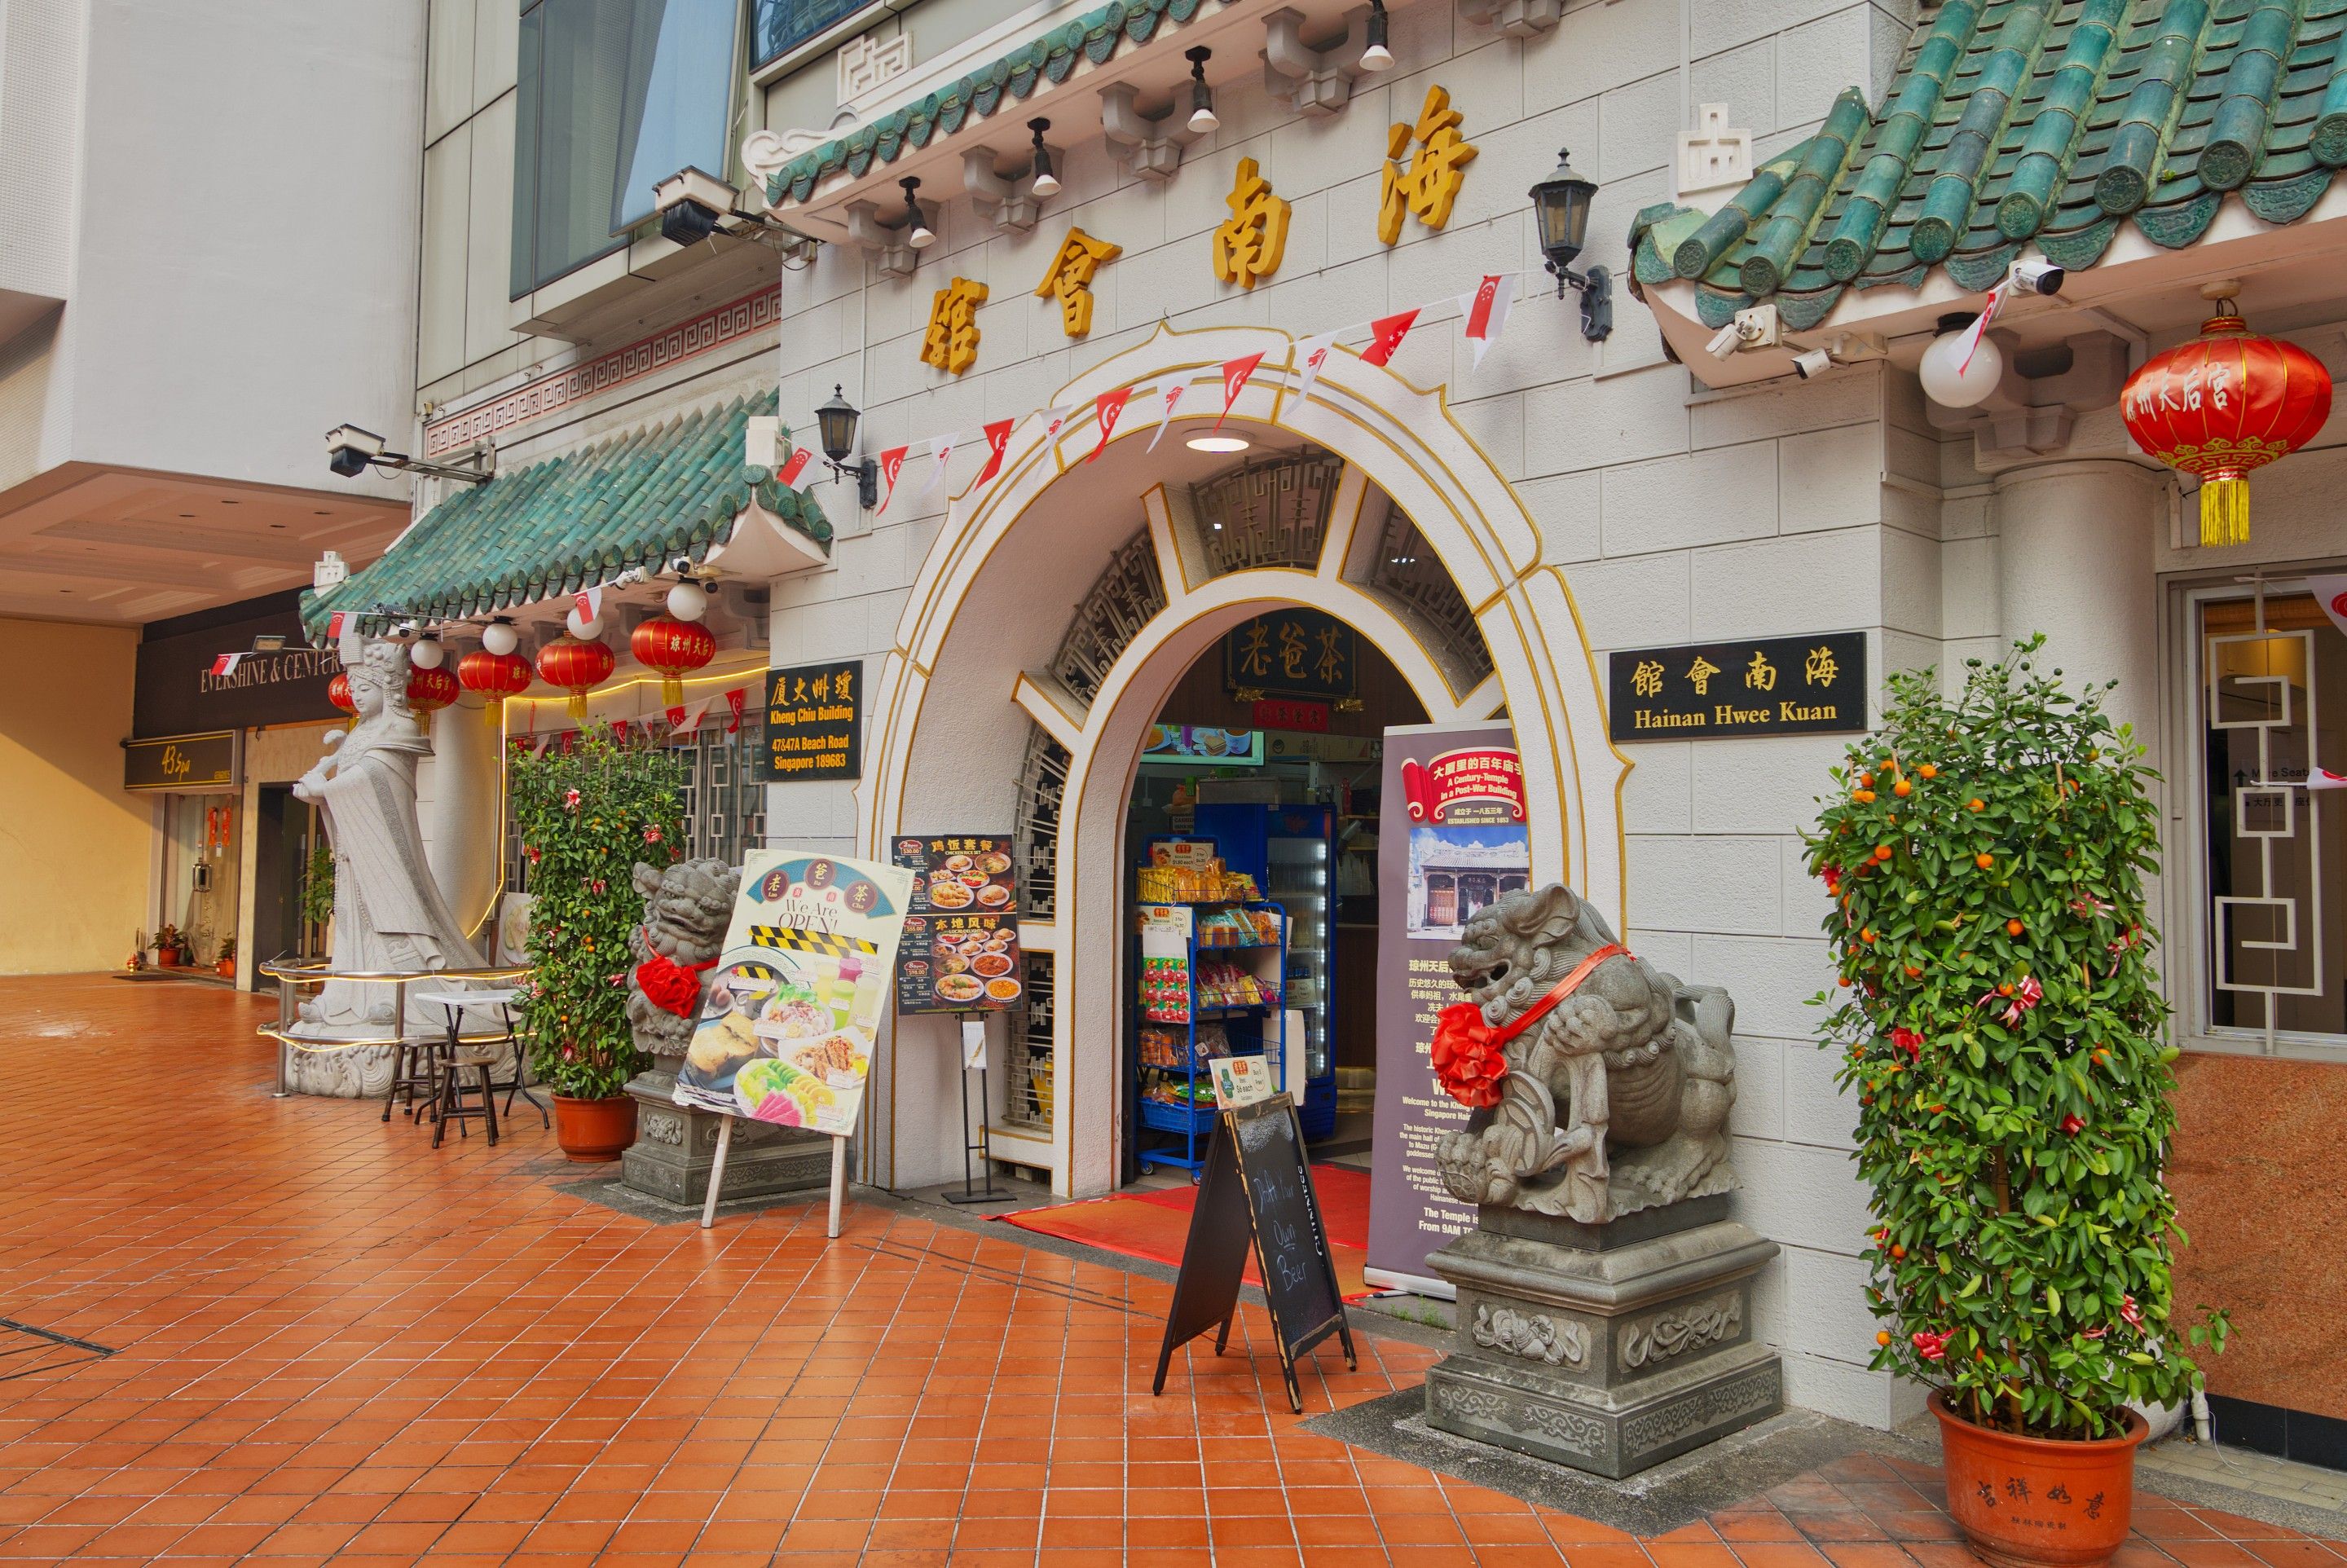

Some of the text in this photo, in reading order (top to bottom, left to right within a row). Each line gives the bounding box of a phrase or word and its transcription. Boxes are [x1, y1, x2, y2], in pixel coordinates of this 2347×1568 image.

[1240, 617, 1344, 685] 老爸茶
[271, 657, 280, 683] &
[284, 652, 347, 680] CENTUR
[1630, 646, 1839, 698] 海南會館
[771, 705, 853, 725] Kheng Chiu Building
[1635, 701, 1837, 729] Hainan Hwee Kuan
[772, 734, 848, 751] 47&47A Beach Road
[161, 746, 175, 774] 43
[775, 754, 845, 772] Singapore 189683
[1447, 773, 1508, 787] A Century-Temple
[1455, 784, 1486, 795] Post-War
[1488, 784, 1517, 799] Building
[931, 839, 993, 852] 鸡饭套餐
[815, 863, 827, 880] 爸
[768, 874, 782, 892] 老
[853, 884, 868, 902] 茶
[786, 899, 837, 916] We Are
[936, 918, 997, 931] 本地风味
[1408, 960, 1453, 973] 琼州天后
[1415, 1014, 1441, 1024] 欢迎会
[1402, 1096, 1429, 1106] Welcome
[1431, 1099, 1438, 1108] to
[1438, 1100, 1449, 1108] the
[1424, 1108, 1456, 1119] Singapore
[1406, 1150, 1434, 1159] goddesses
[1412, 1167, 1436, 1175] welcome
[1423, 1176, 1438, 1184] public
[1420, 1185, 1441, 1194] worship
[1430, 1194, 1458, 1204] Hainanese
[1424, 1207, 1478, 1224] The Temple is
[1274, 1220, 1296, 1245] Own
[1419, 1220, 1439, 1232] From
[1442, 1224, 1460, 1235] 9AM
[1277, 1254, 1306, 1291] Beer
